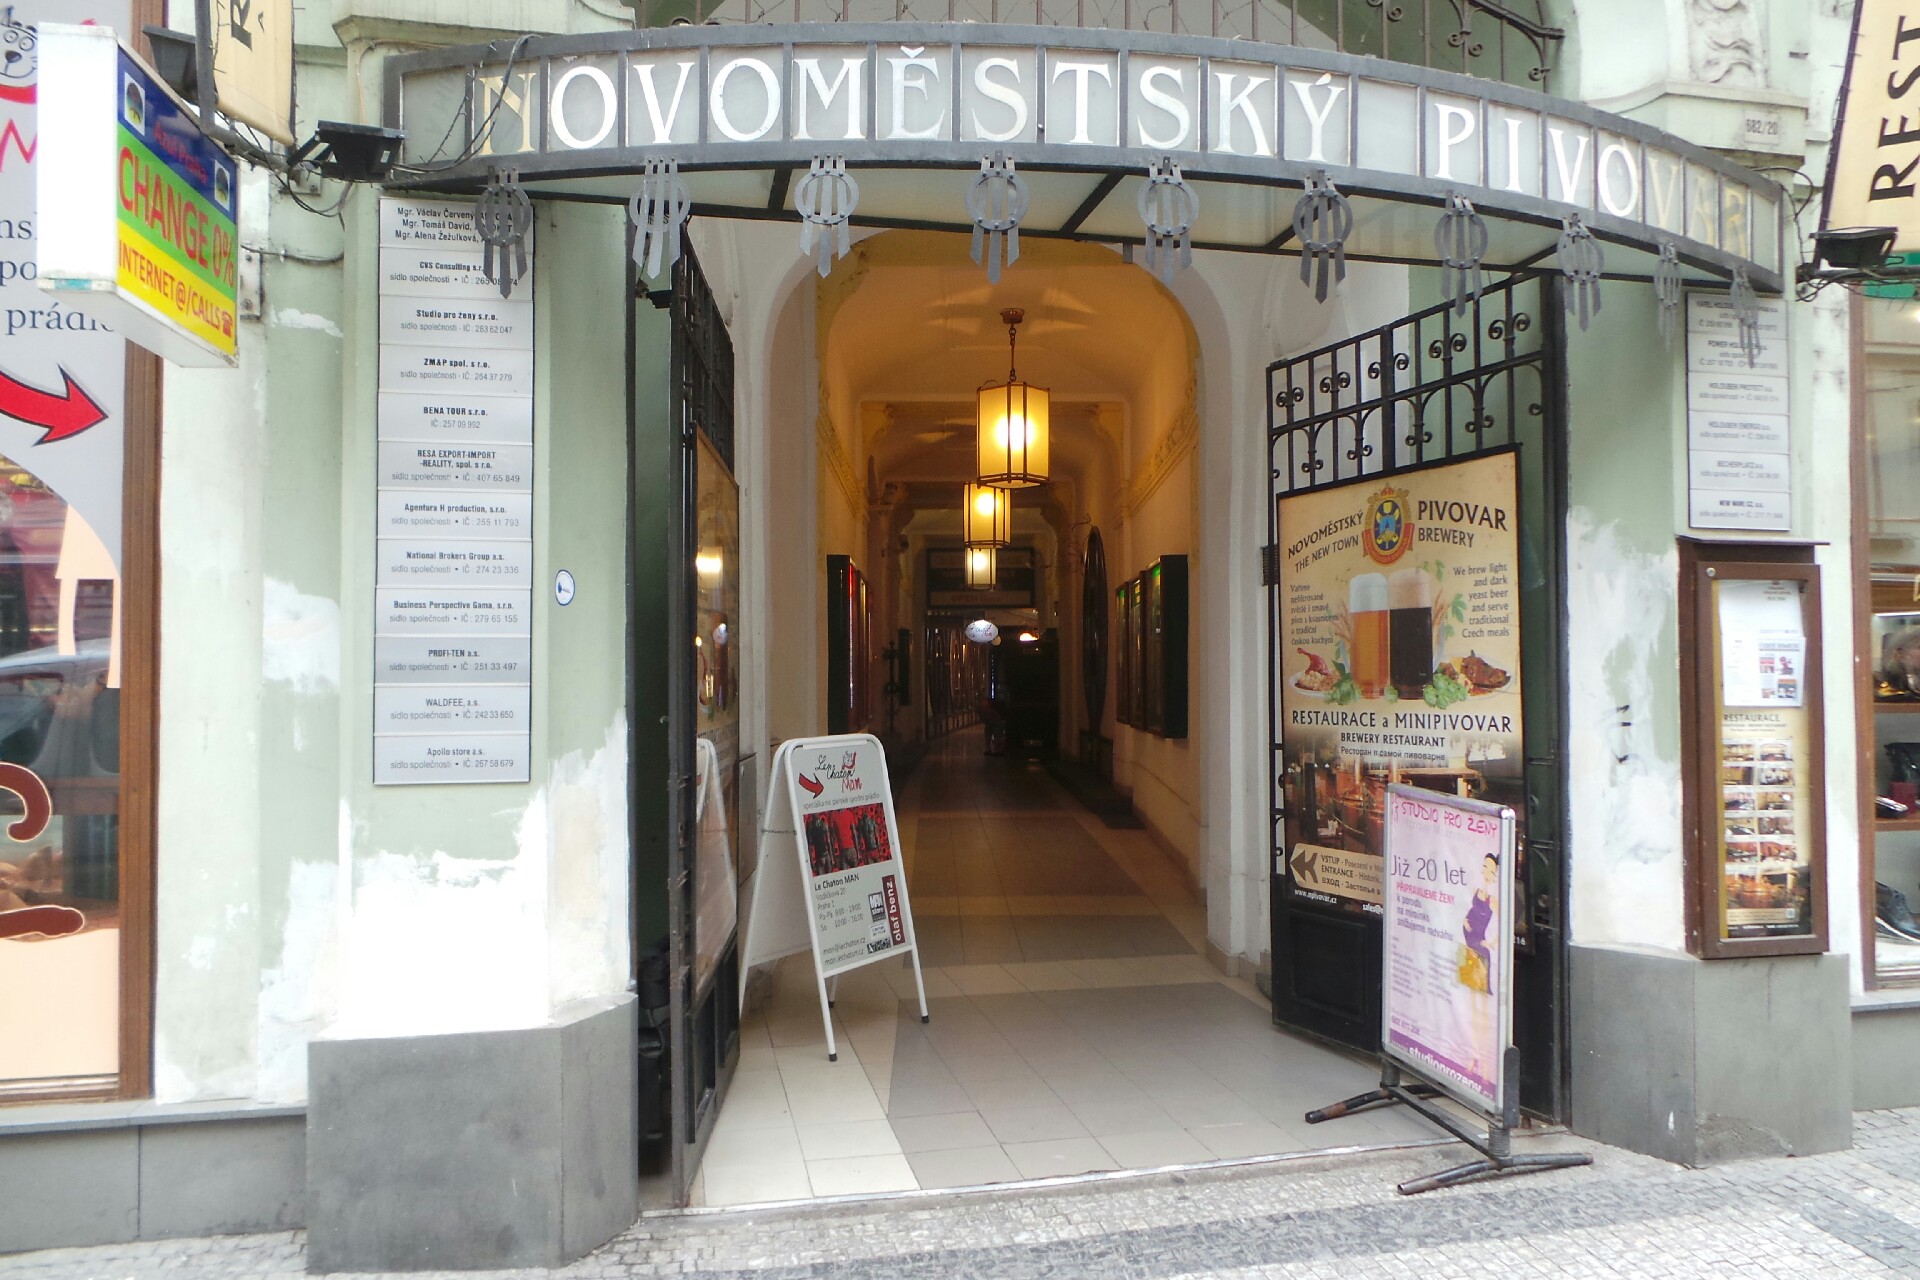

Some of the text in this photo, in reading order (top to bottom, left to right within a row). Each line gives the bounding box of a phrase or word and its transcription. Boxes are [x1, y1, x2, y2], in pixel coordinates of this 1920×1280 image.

[1745, 119, 1779, 135] 682/20
[479, 45, 1747, 260] NOVOMĚSTSKÝ PIVOVAR
[118, 146, 208, 270] CHANGE
[213, 223, 235, 289] 0%
[398, 208, 414, 217] Mgr.
[416, 208, 441, 216] Václav
[403, 219, 471, 231] Mgr. Tomáš David,
[395, 230, 411, 240] Mgr.
[415, 231, 436, 240] Alena
[435, 263, 470, 271] Consulting
[119, 240, 220, 332] INTERNET@/CALLS
[417, 309, 441, 318] Studio
[424, 358, 447, 366] ZM&P
[447, 407, 466, 415] TOUR
[439, 450, 496, 458] EXPORT-IMPORT
[456, 461, 472, 469] spol.
[493, 474, 503, 482] 65
[405, 504, 437, 512] Agentura
[1288, 509, 1363, 559] NOVOMĚSTSKÝ
[1418, 500, 1507, 531] PIVOVAR
[1295, 556, 1309, 573] THE
[1312, 544, 1330, 562] NEW
[1333, 535, 1359, 553] TOWN
[1418, 527, 1474, 548] BREWERY
[407, 551, 436, 559] National
[439, 552, 466, 560] Brokers
[469, 553, 490, 561] Group
[1453, 563, 1507, 576] We brew light
[1474, 575, 1508, 586] and dark
[1469, 589, 1508, 601] yeast beer
[430, 601, 470, 610] Perspective
[1472, 603, 1508, 612] and serve
[1469, 614, 1508, 625] traditional
[1462, 627, 1509, 638] Czech meals
[426, 699, 465, 707] WALDFEE,
[1292, 710, 1375, 727] RESTAURACE
[1396, 713, 1512, 733] MINIPIVOVAR
[1724, 714, 1780, 722] RESTAURACE
[1341, 733, 1445, 747] BREWERY RESTAURANT
[427, 748, 450, 757] Apollo
[1341, 747, 1371, 755] Ресторан
[1404, 753, 1445, 761] пивоварне
[1402, 802, 1497, 837] STUDIO PRO ŽENY
[1321, 855, 1339, 864] VSTUP
[1322, 865, 1353, 878] ENTRANCE
[1391, 855, 1467, 885] Již 20 let
[823, 879, 843, 889] Chaton
[845, 874, 860, 883] MAN
[886, 881, 901, 940] olaf benz
